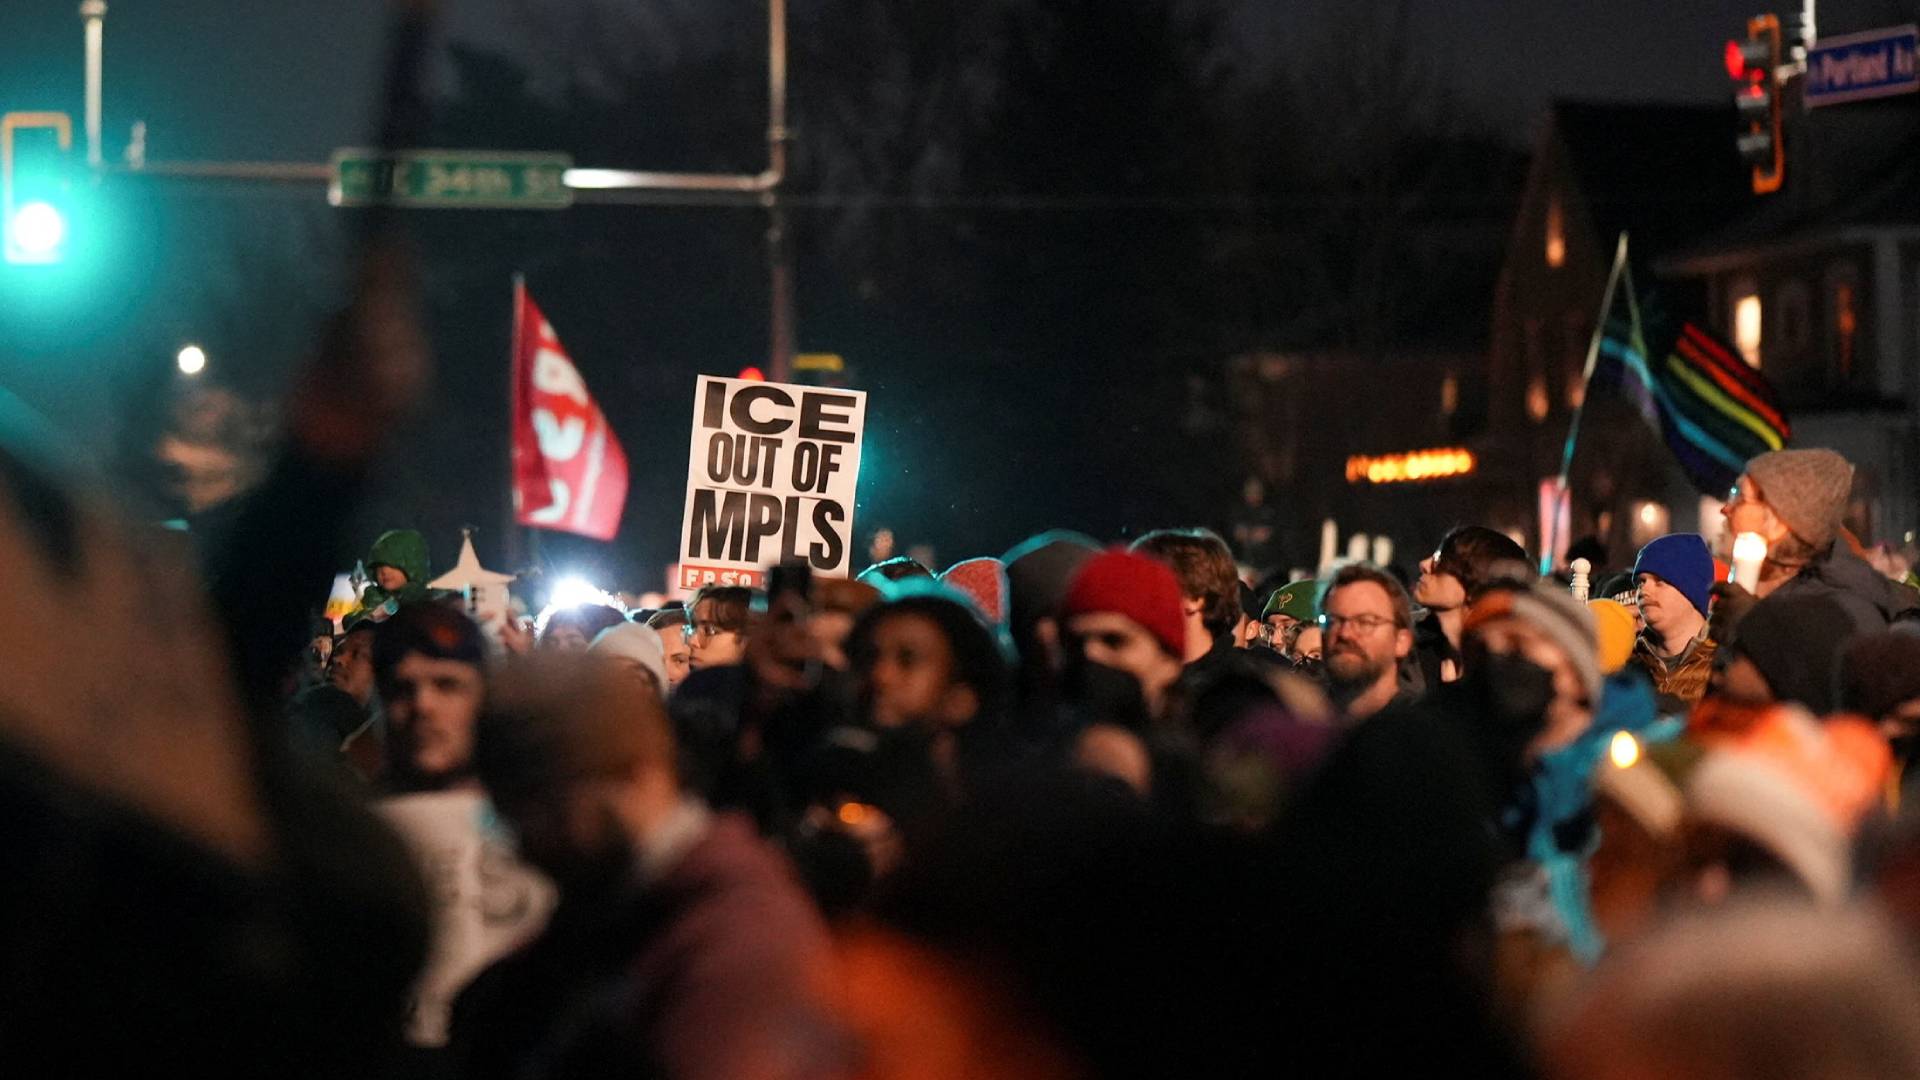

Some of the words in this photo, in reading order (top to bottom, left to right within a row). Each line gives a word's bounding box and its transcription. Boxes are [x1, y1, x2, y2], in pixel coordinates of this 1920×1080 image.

[703, 381, 856, 443] ICE
[707, 432, 783, 488] OUT
[792, 441, 842, 493] OF
[688, 489, 845, 570] MPLS
